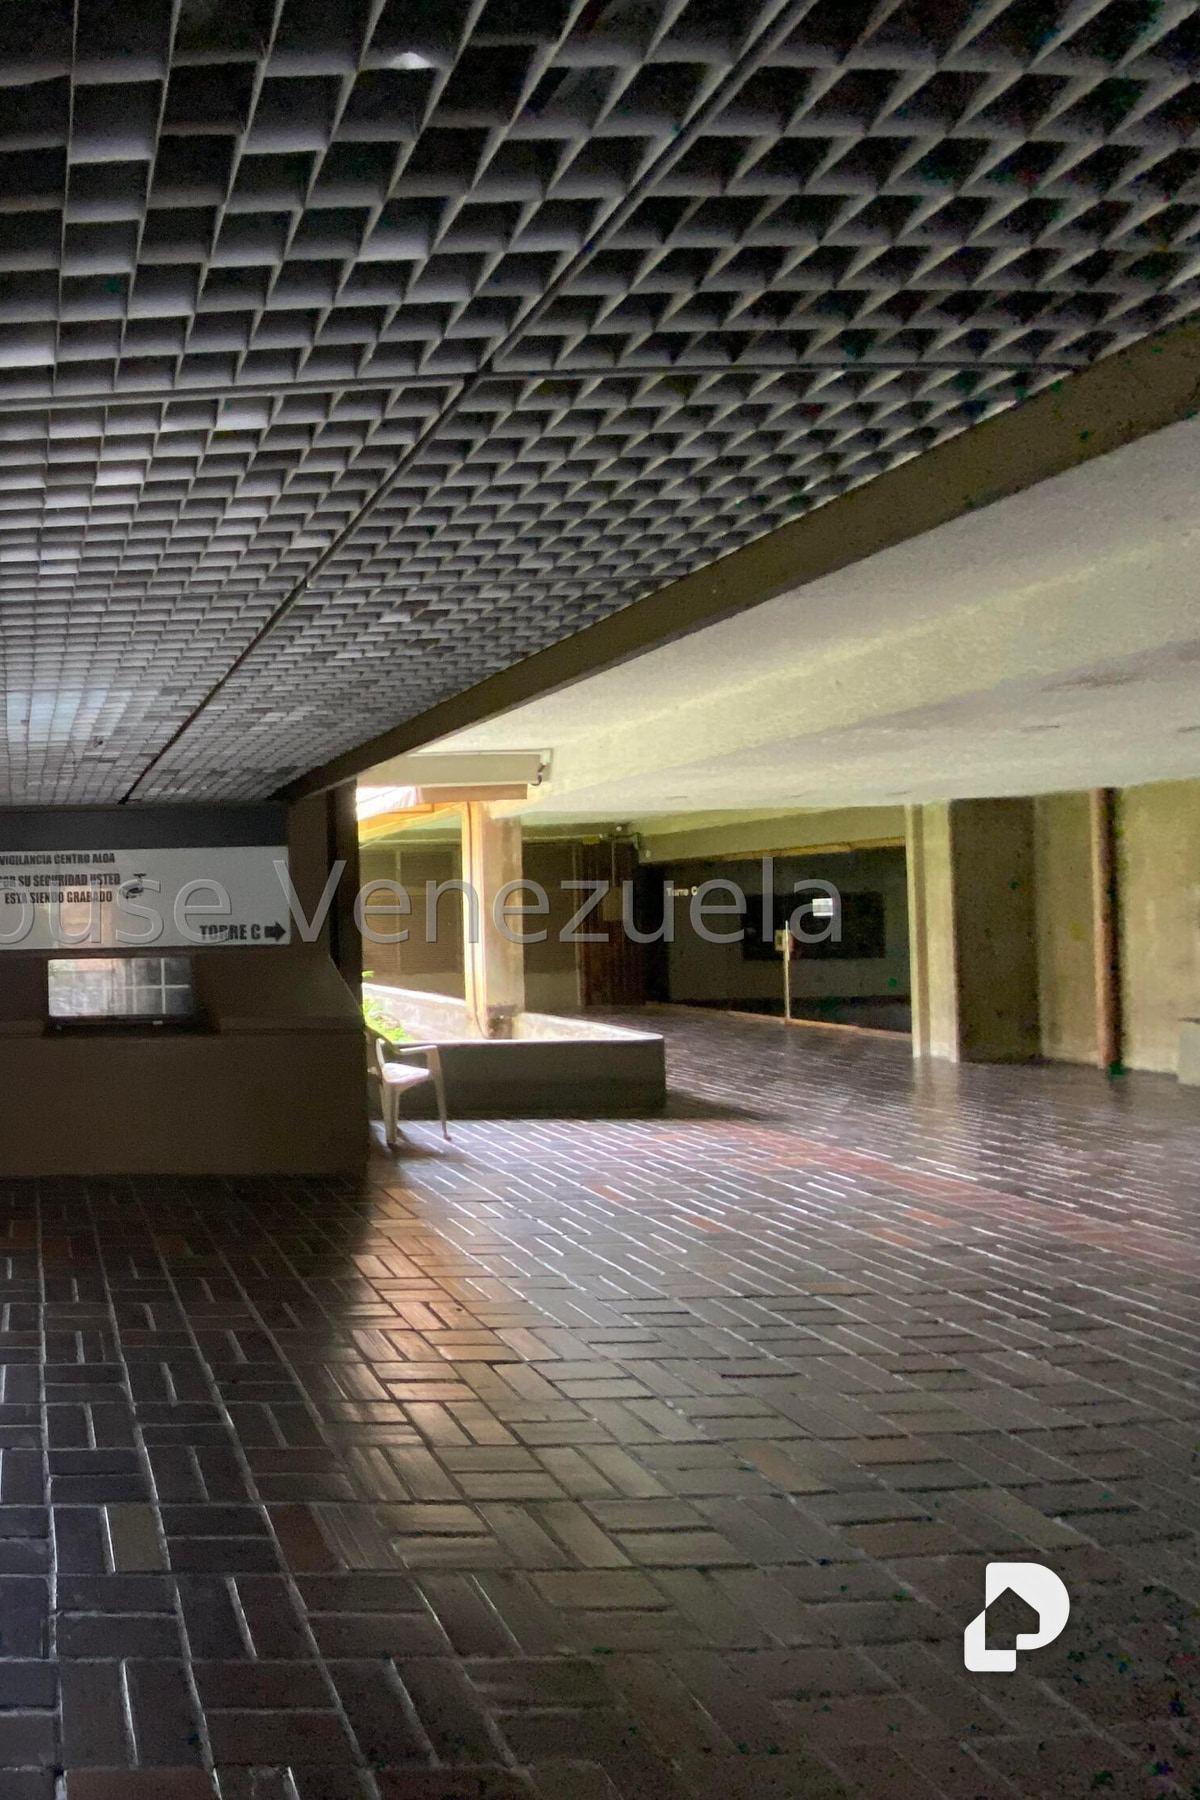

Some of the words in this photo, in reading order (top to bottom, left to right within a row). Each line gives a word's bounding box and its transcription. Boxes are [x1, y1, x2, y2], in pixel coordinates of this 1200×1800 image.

[0, 854, 52, 865] VIGILANCIA
[54, 854, 90, 865] CENTRO
[18, 875, 31, 887] SU
[33, 873, 88, 887] SEGURIDAD
[89, 873, 121, 886] USTED
[5, 892, 27, 904] ESTA
[30, 891, 64, 904] SIENDO
[66, 891, 113, 903] GRABADO
[199, 924, 247, 940] TORRE
[250, 924, 261, 940] C
